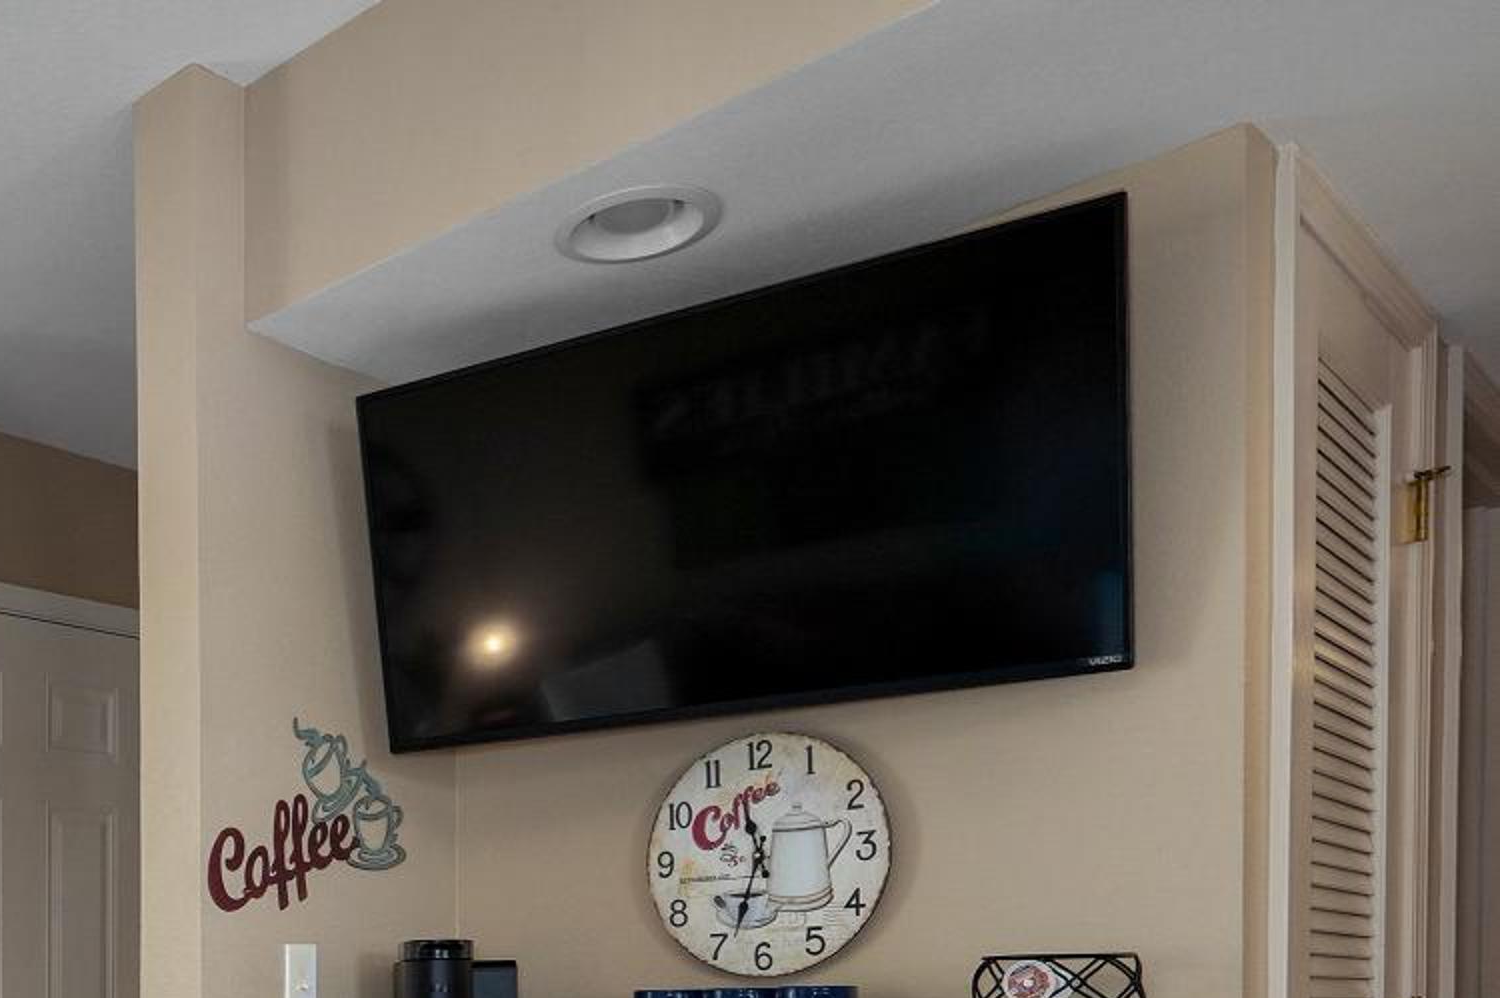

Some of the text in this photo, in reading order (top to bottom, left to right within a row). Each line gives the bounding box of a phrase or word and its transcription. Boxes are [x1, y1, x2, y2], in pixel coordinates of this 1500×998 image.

[747, 740, 773, 770] 12
[806, 745, 816, 774] 1
[705, 759, 721, 789] 11
[846, 779, 864, 810] 2
[669, 801, 693, 831] 10
[691, 780, 781, 851] Coffee
[207, 793, 360, 912] Coffee
[855, 829, 877, 861] 3
[657, 851, 675, 878] 9
[669, 899, 688, 927] 8
[844, 887, 866, 916] 4
[709, 933, 728, 961] 7
[754, 942, 773, 970] 6
[805, 926, 825, 956] 5
